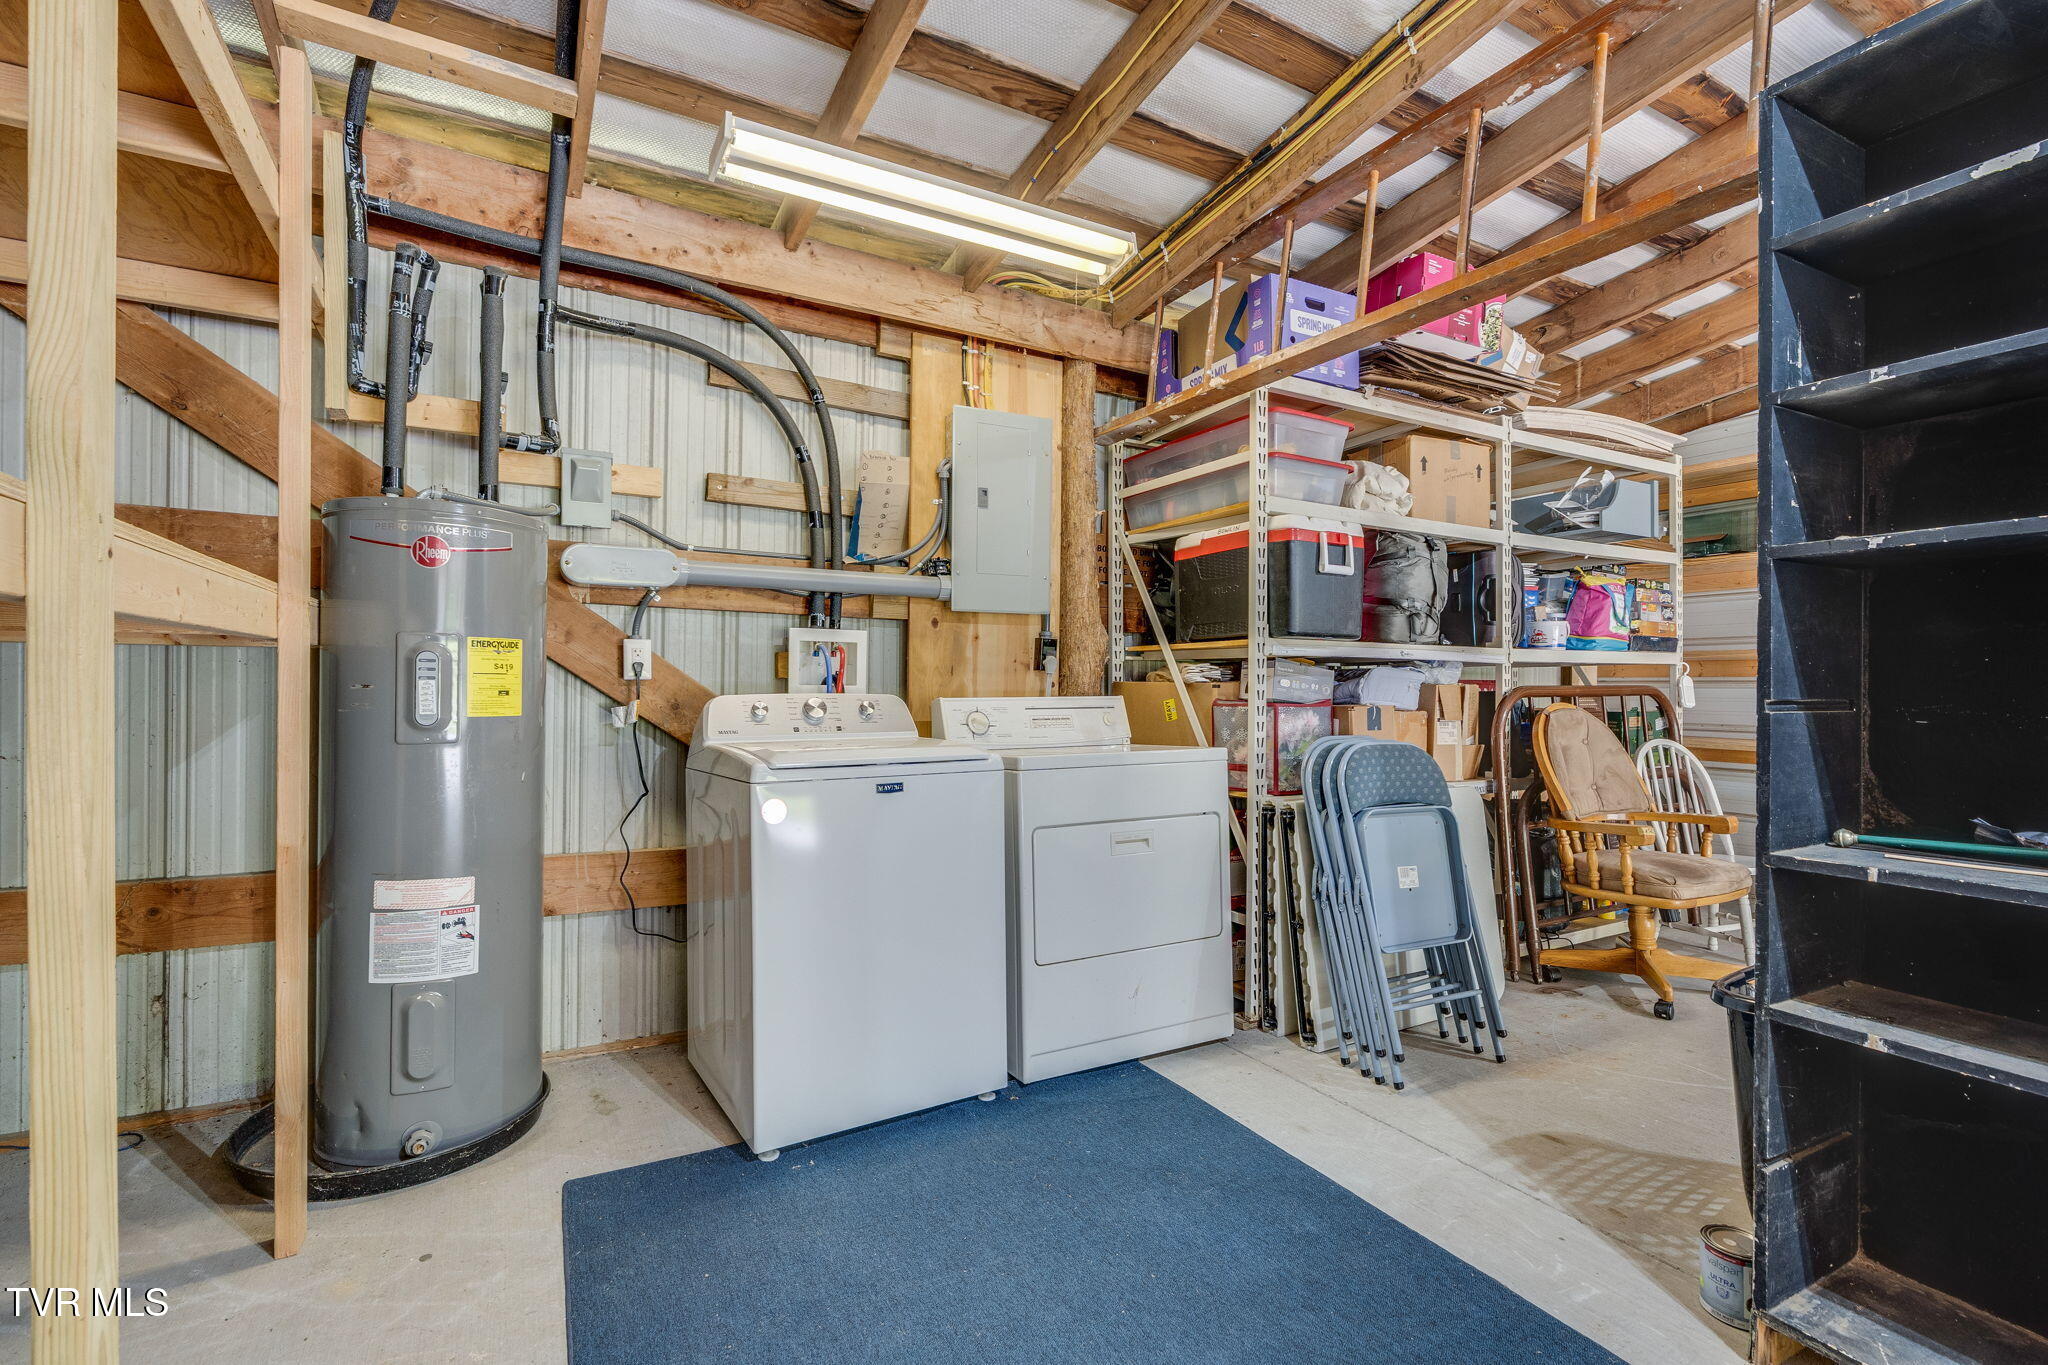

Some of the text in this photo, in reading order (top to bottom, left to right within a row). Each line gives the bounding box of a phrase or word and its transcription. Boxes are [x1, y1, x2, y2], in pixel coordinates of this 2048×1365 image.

[1297, 315, 1323, 333] SPRING
[375, 521, 489, 539] PERFOMANCE PLUS
[416, 536, 449, 563] Rheem
[471, 639, 519, 650] ENERGYGUIDE
[877, 784, 903, 792] MAYTAG
[449, 907, 474, 916] DANGER
[1709, 1272, 1737, 1289] ULTRA
